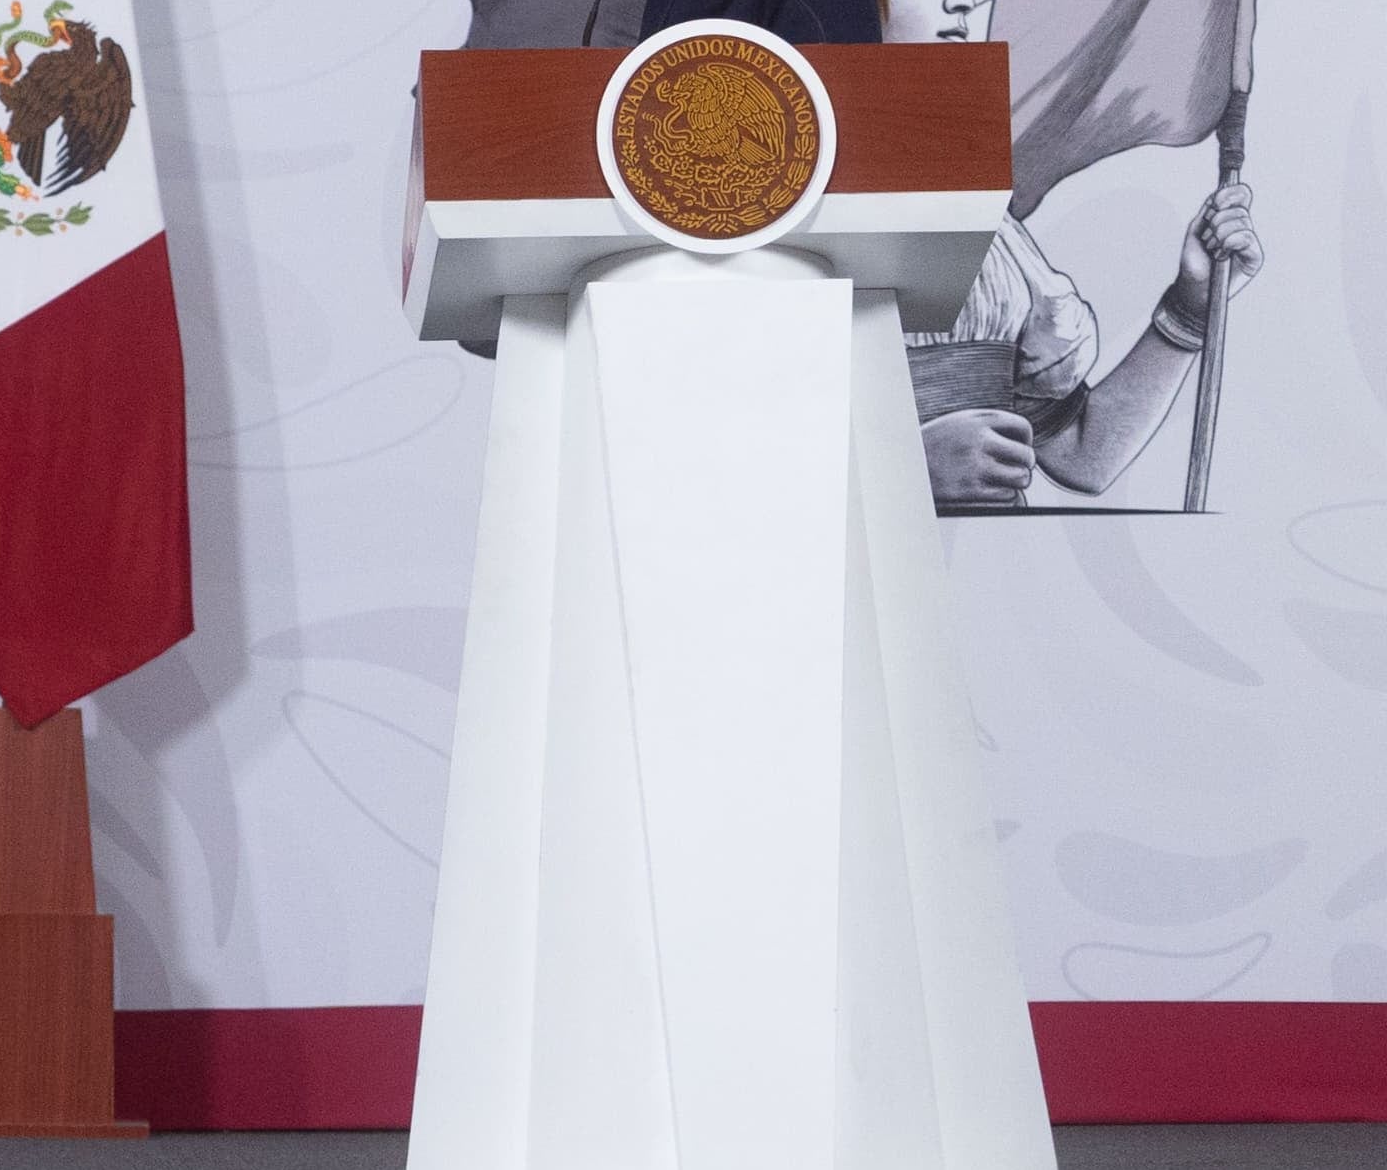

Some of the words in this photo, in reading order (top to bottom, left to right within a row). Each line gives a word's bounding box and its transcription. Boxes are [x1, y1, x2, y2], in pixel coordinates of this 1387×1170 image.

[617, 57, 665, 138] ESTADOS
[663, 39, 735, 67] UNIDOS
[737, 41, 815, 134] MEXICANOS
